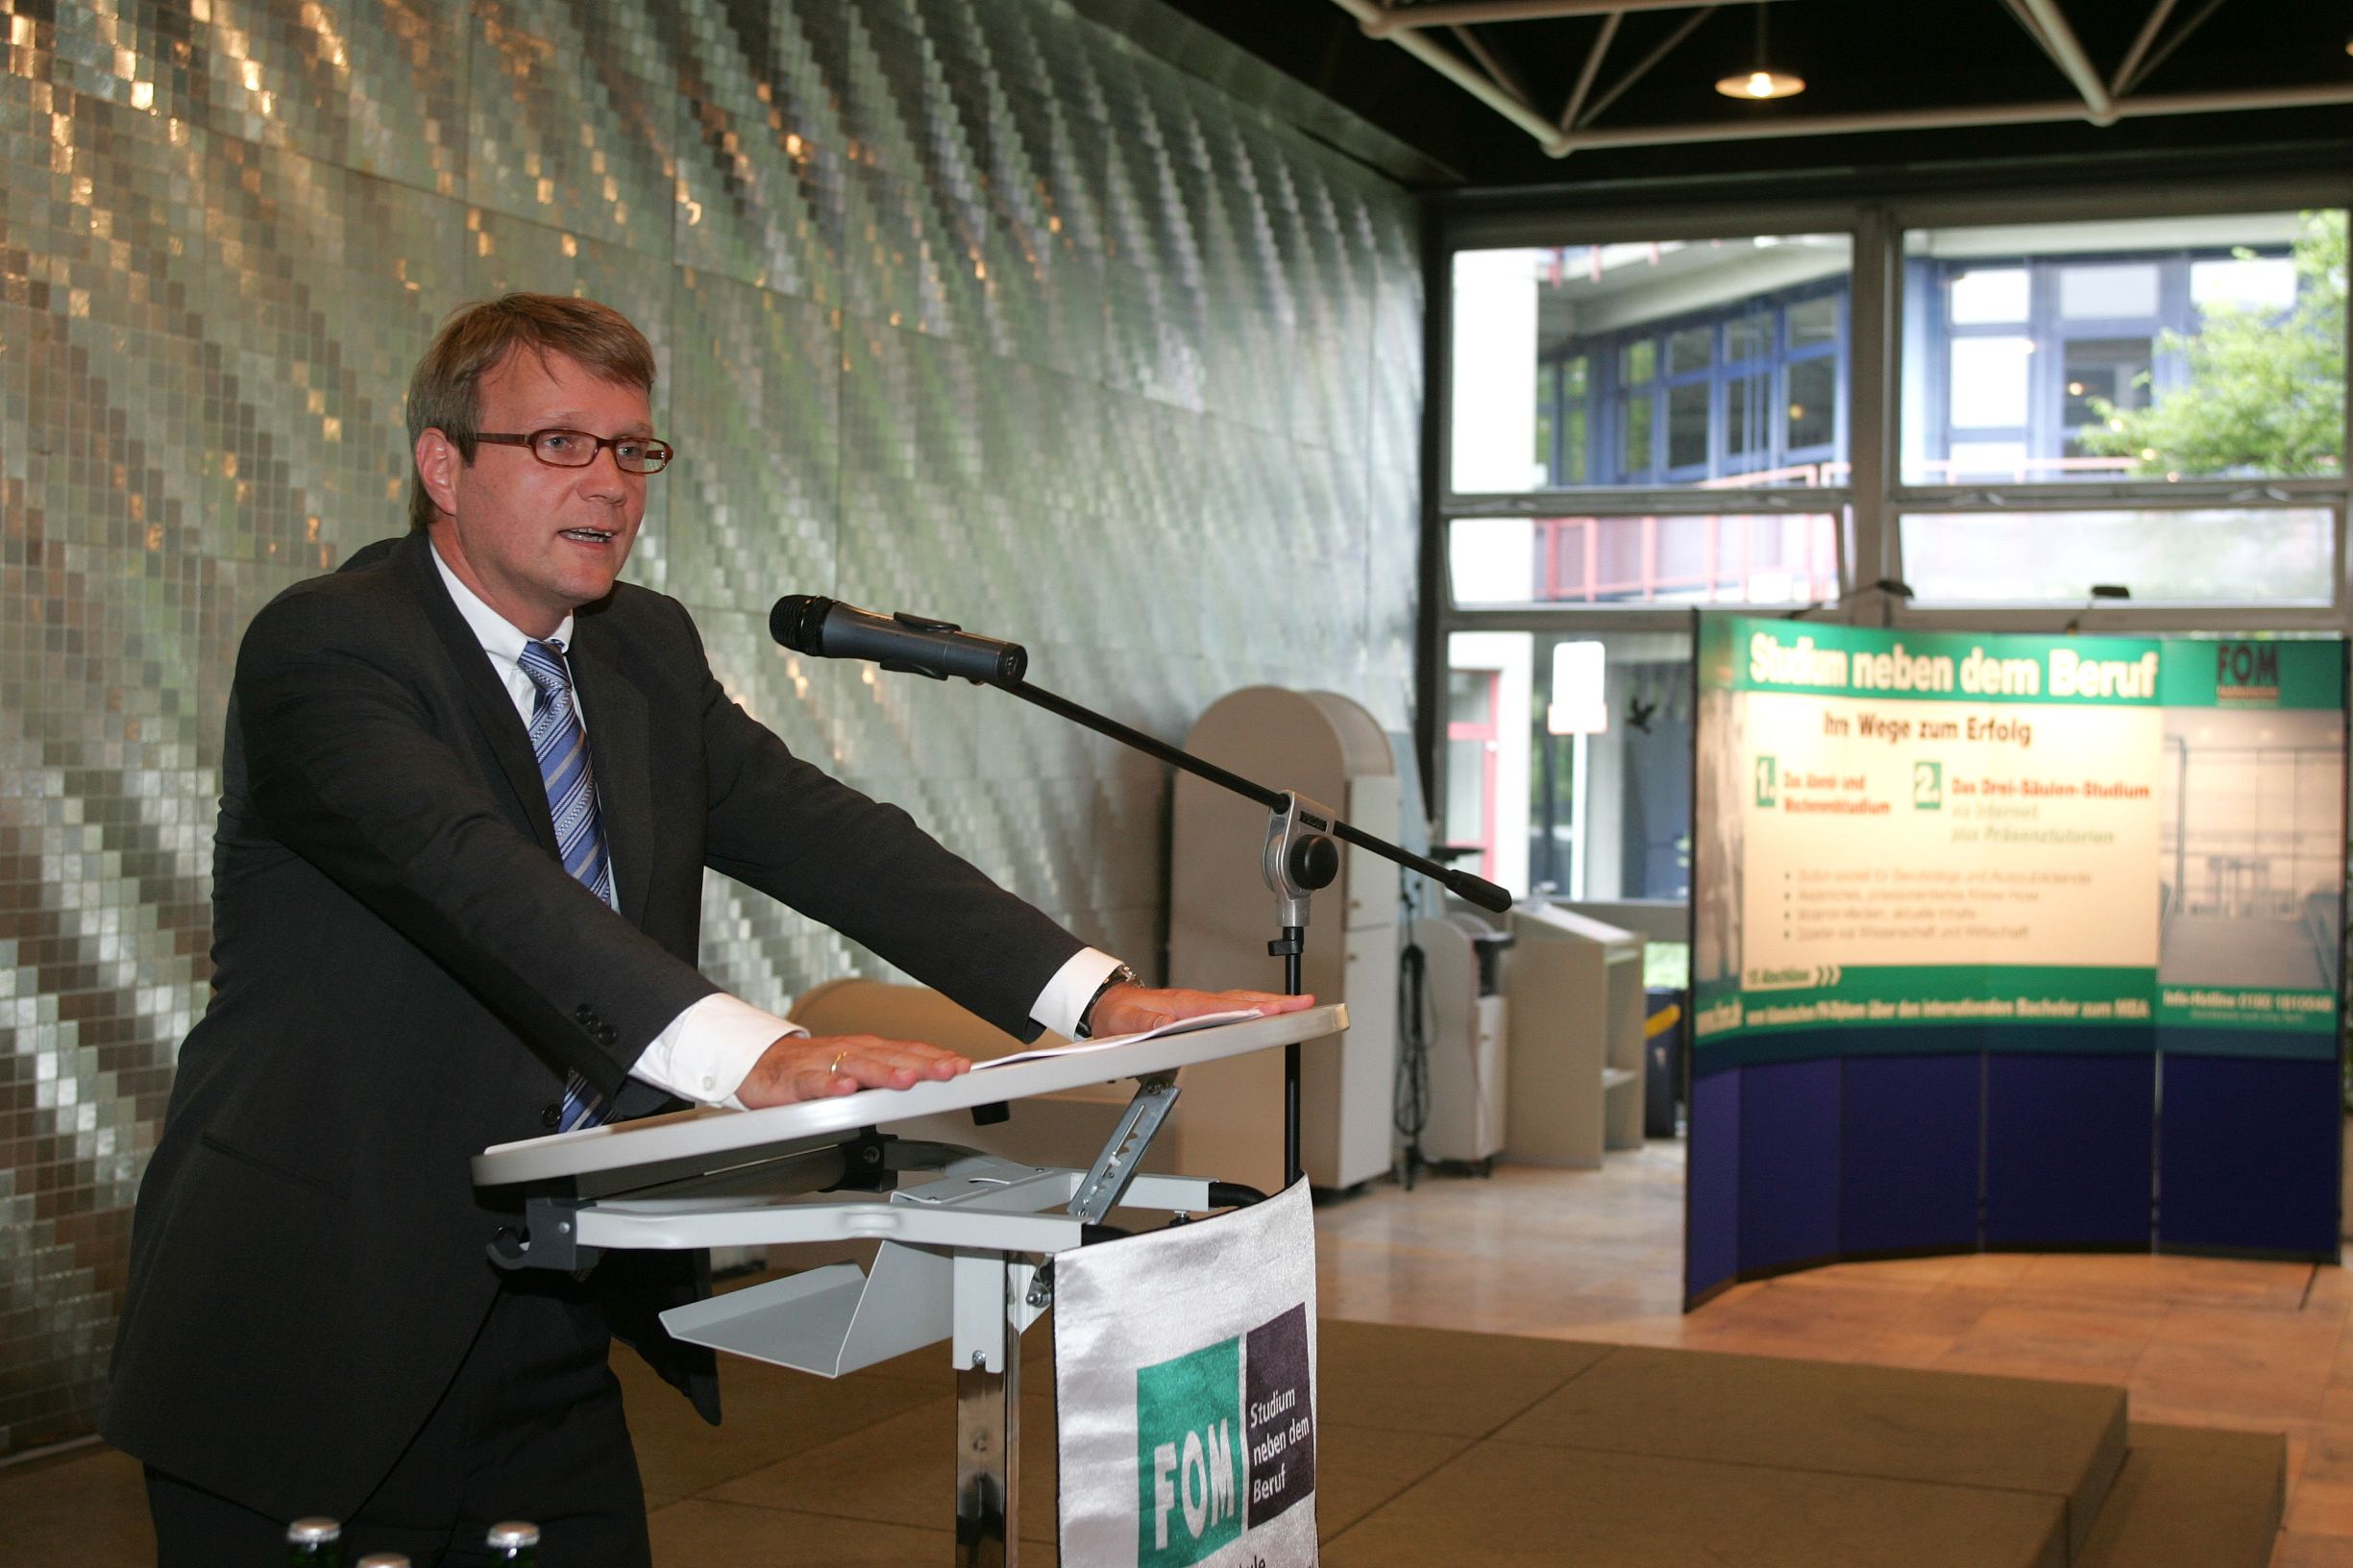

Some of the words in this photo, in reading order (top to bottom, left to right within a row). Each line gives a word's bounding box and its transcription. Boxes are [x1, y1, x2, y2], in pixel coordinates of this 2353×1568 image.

[1750, 632, 1848, 689] Studium
[1852, 643, 1954, 693] neben
[1959, 646, 2041, 696] dem
[2048, 649, 2159, 698] Beruf
[2218, 644, 2278, 685] FOM
[1858, 713, 1910, 746] Wege
[1919, 721, 1958, 739] zum
[1967, 717, 2031, 747] Erfolg
[1250, 1388, 1295, 1429] Studium
[1253, 1429, 1287, 1466] neben
[1288, 1416, 1310, 1445] dem
[1154, 1417, 1235, 1550] FOM
[1253, 1462, 1287, 1504] Beruf
